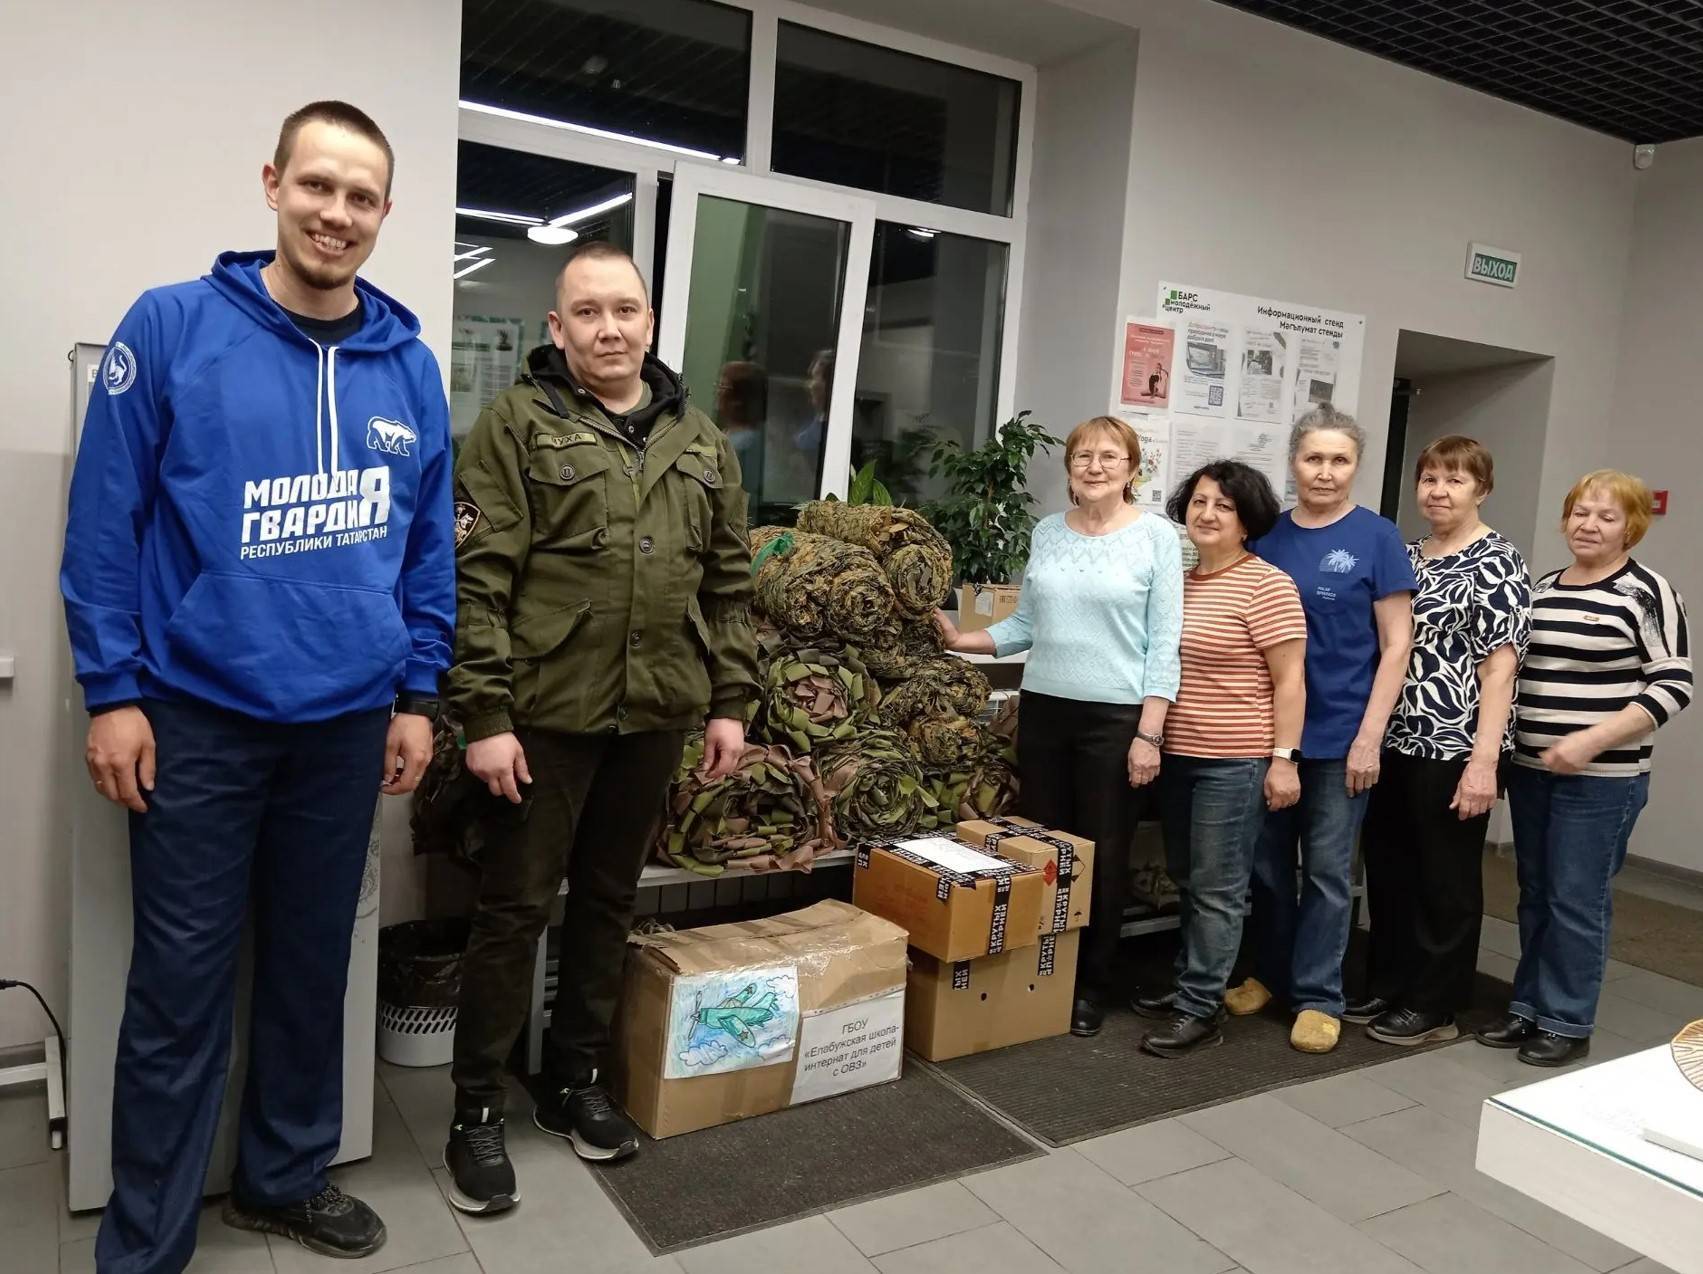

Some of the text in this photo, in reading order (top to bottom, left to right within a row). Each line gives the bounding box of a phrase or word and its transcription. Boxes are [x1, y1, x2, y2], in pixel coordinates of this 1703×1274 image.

[1473, 257, 1514, 281] ВЫХОД
[1178, 291, 1198, 302] БАРС
[1257, 306, 1344, 329] Информационный стенд
[1318, 328, 1344, 338] стенды
[240, 525, 388, 560] РЕСПУБЛИКИ ТАТАРСТАН
[842, 1018, 868, 1034] ГБОУ
[804, 1025, 899, 1058] «Елабужская школа-
[804, 1037, 897, 1071] интернат для детей
[832, 1060, 867, 1077] с ОВЗ»
